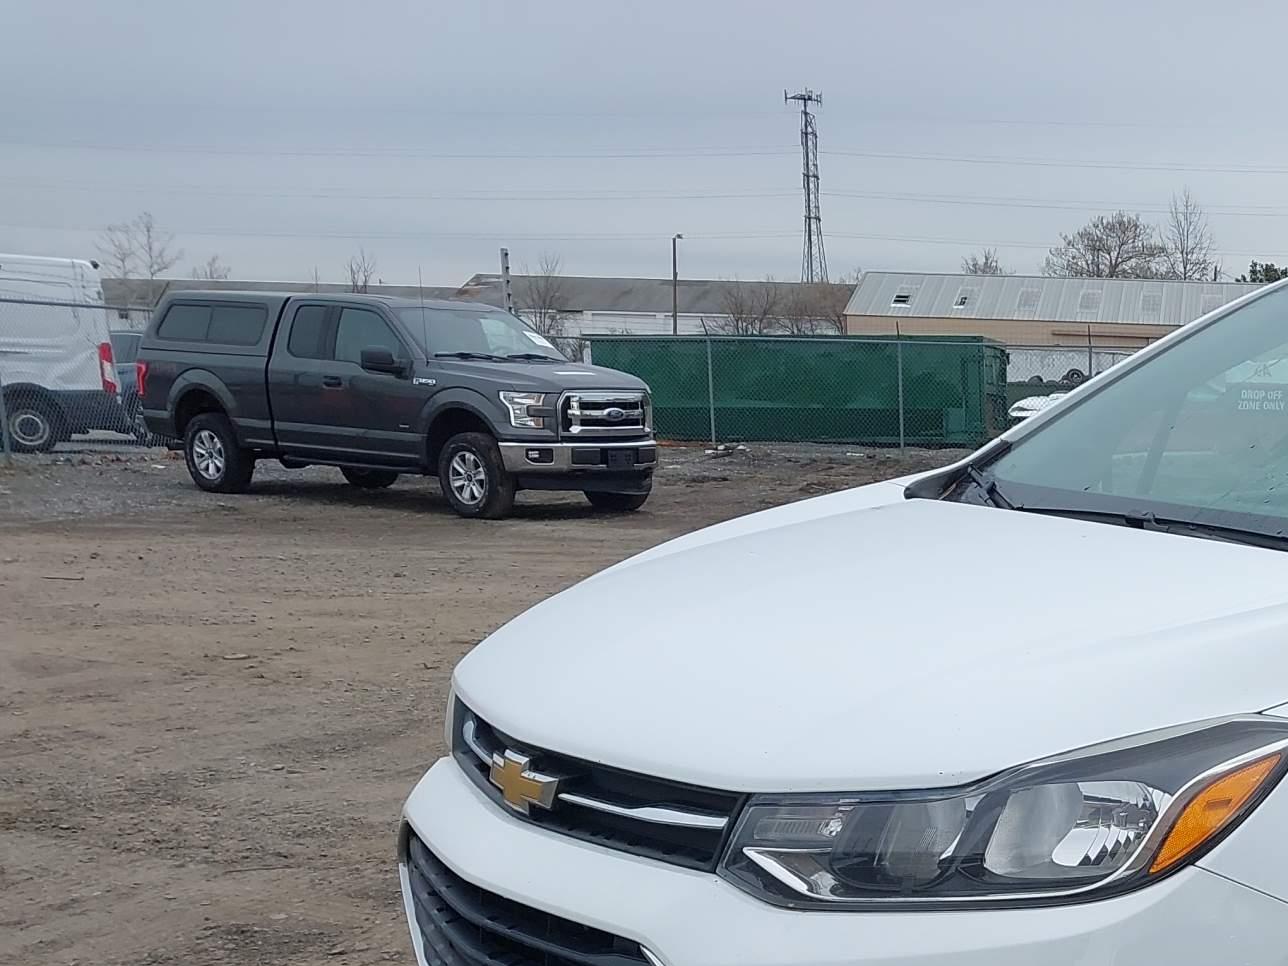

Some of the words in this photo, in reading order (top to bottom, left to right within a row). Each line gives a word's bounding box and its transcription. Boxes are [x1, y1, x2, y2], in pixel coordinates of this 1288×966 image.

[1241, 390, 1265, 399] DROP
[1268, 390, 1283, 399] OFF
[1238, 401, 1260, 410] ZONE
[1263, 400, 1285, 410] ONLY
